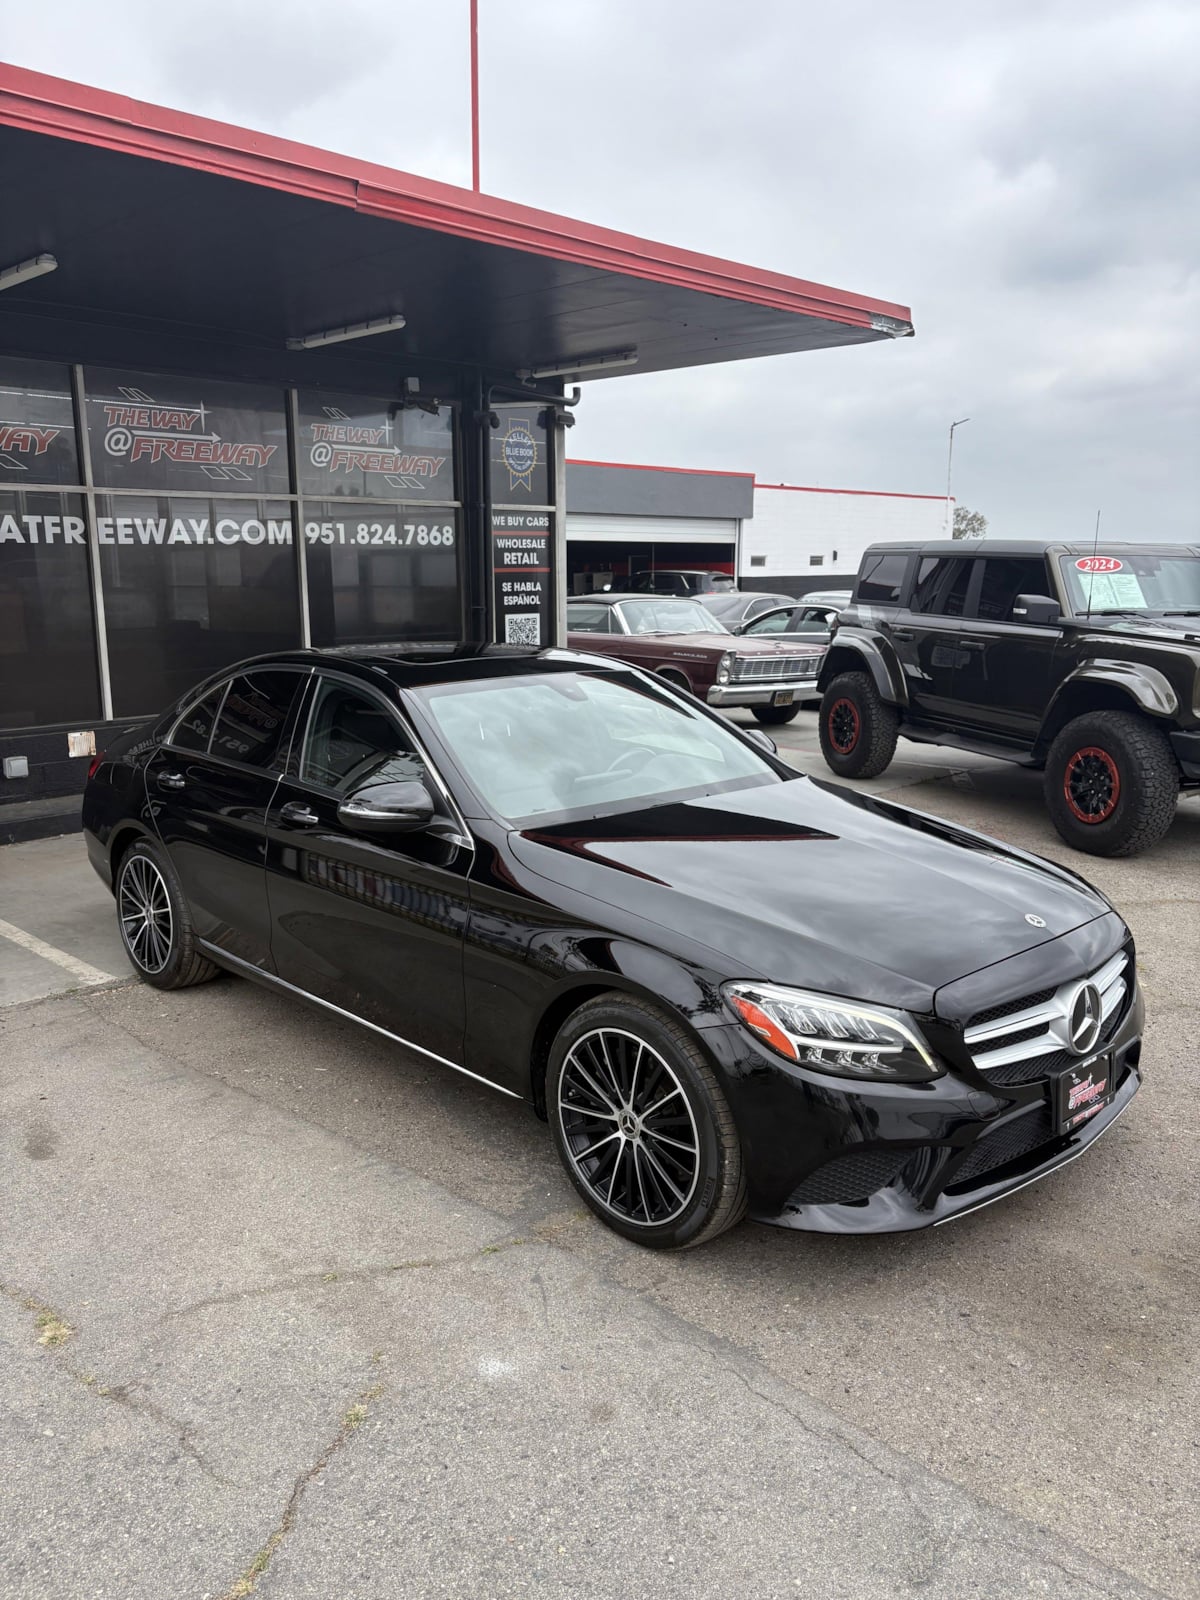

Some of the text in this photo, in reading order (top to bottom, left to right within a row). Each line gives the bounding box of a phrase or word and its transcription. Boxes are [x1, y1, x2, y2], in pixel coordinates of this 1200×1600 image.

[104, 406, 200, 430] THE WAY
[311, 423, 385, 444] THE WAY
[505, 446, 534, 457] BLUE BOOK
[492, 516, 549, 527] WE BUY CARS
[305, 522, 454, 546] 951.824.7868
[496, 538, 546, 549] WHOLESALE
[503, 552, 539, 565] RETAIL
[1084, 559, 1115, 570] 2024
[502, 581, 542, 592] SE HABLA
